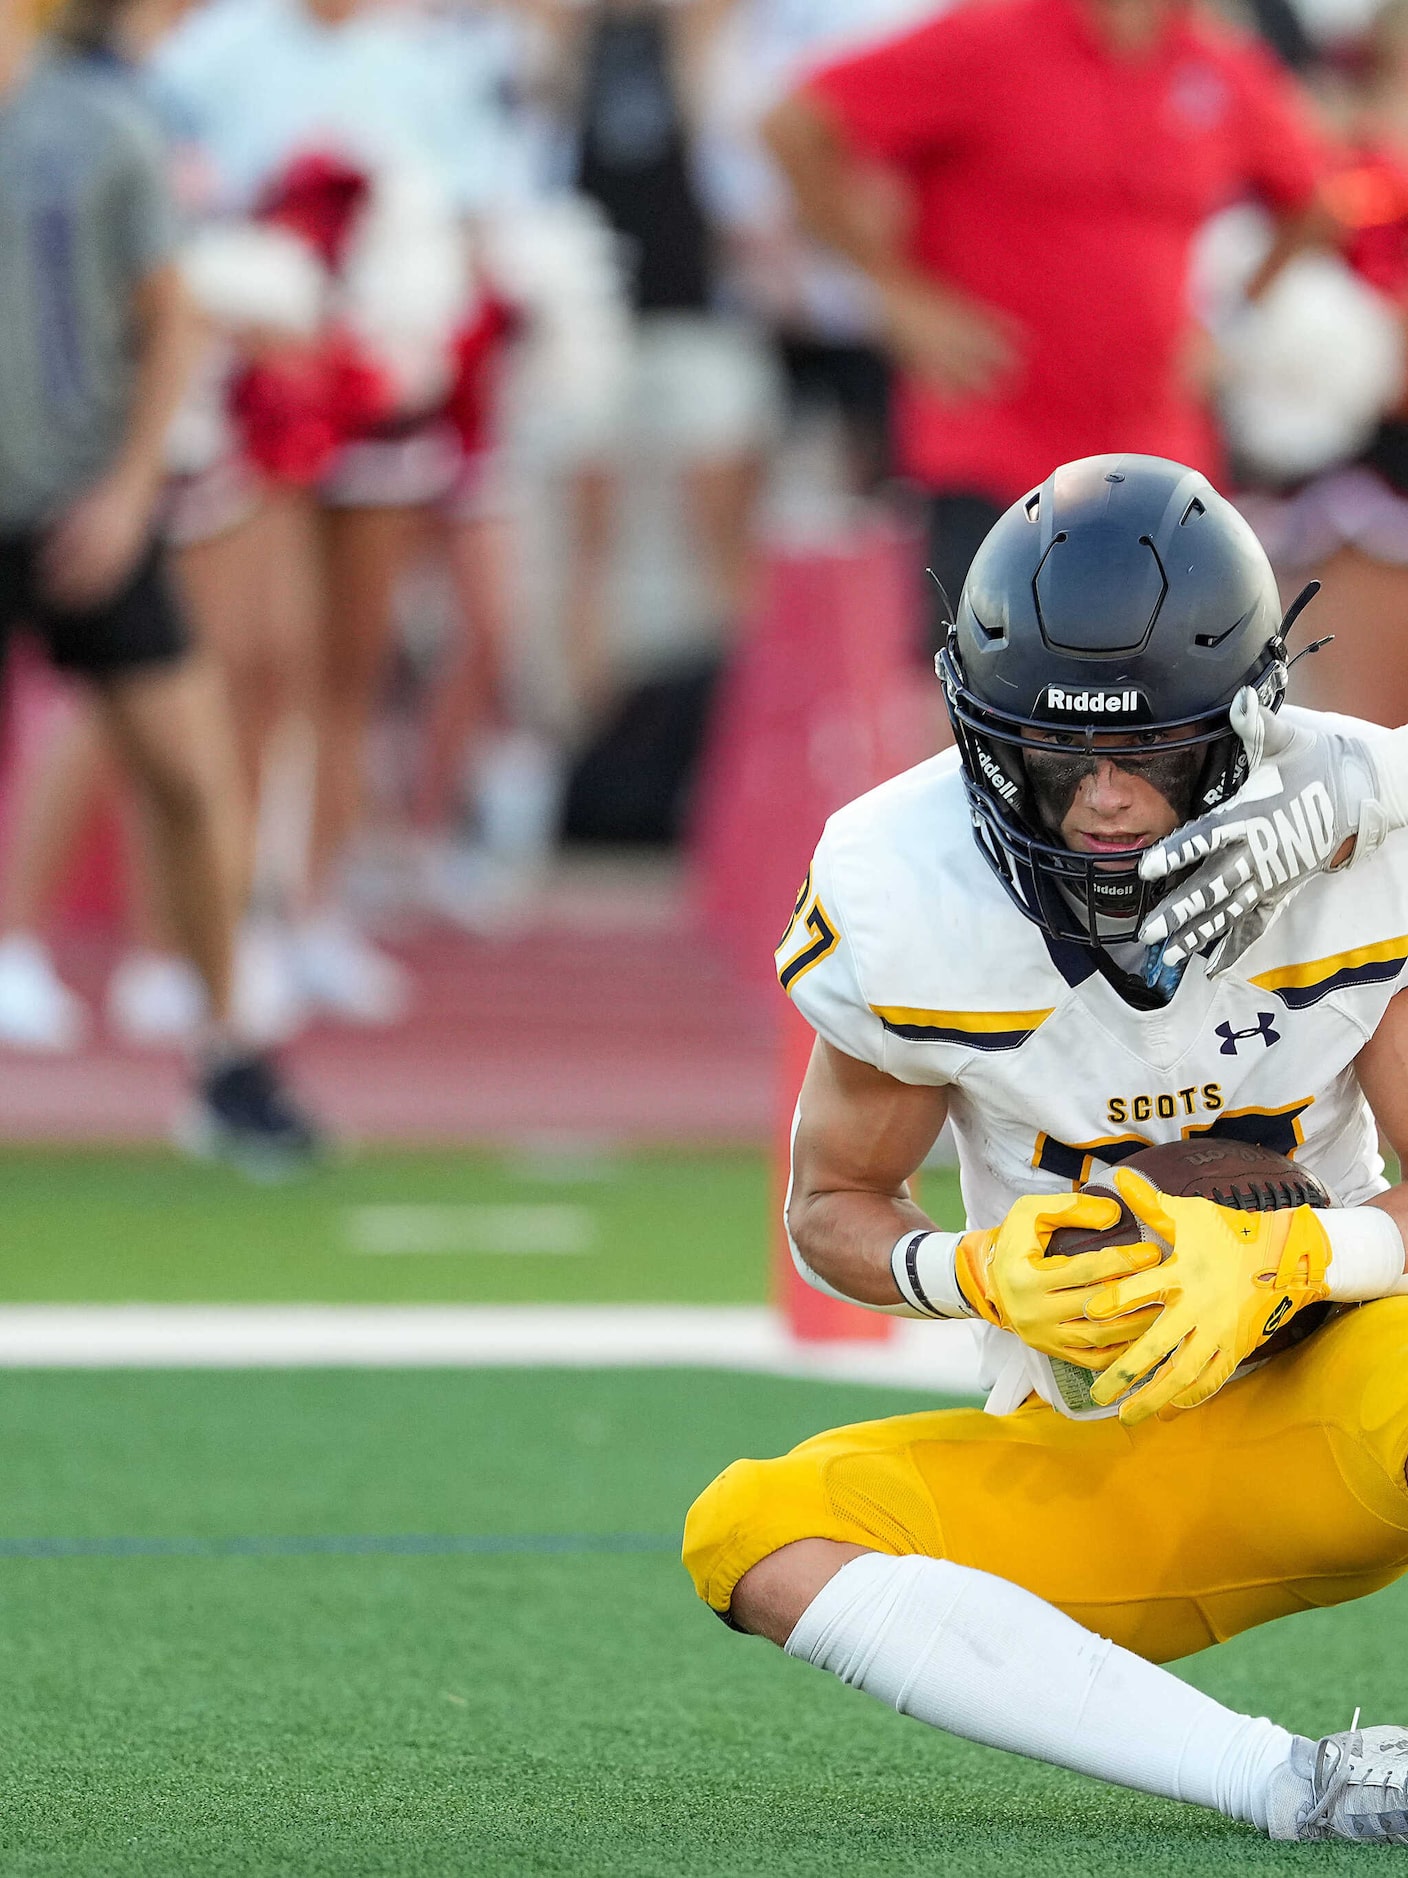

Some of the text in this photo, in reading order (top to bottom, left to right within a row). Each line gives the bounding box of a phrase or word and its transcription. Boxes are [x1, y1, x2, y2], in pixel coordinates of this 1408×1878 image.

[1047, 688, 1138, 712] Riddell
[1093, 882, 1134, 896] iddell
[1106, 1082, 1225, 1125] SCOTS
